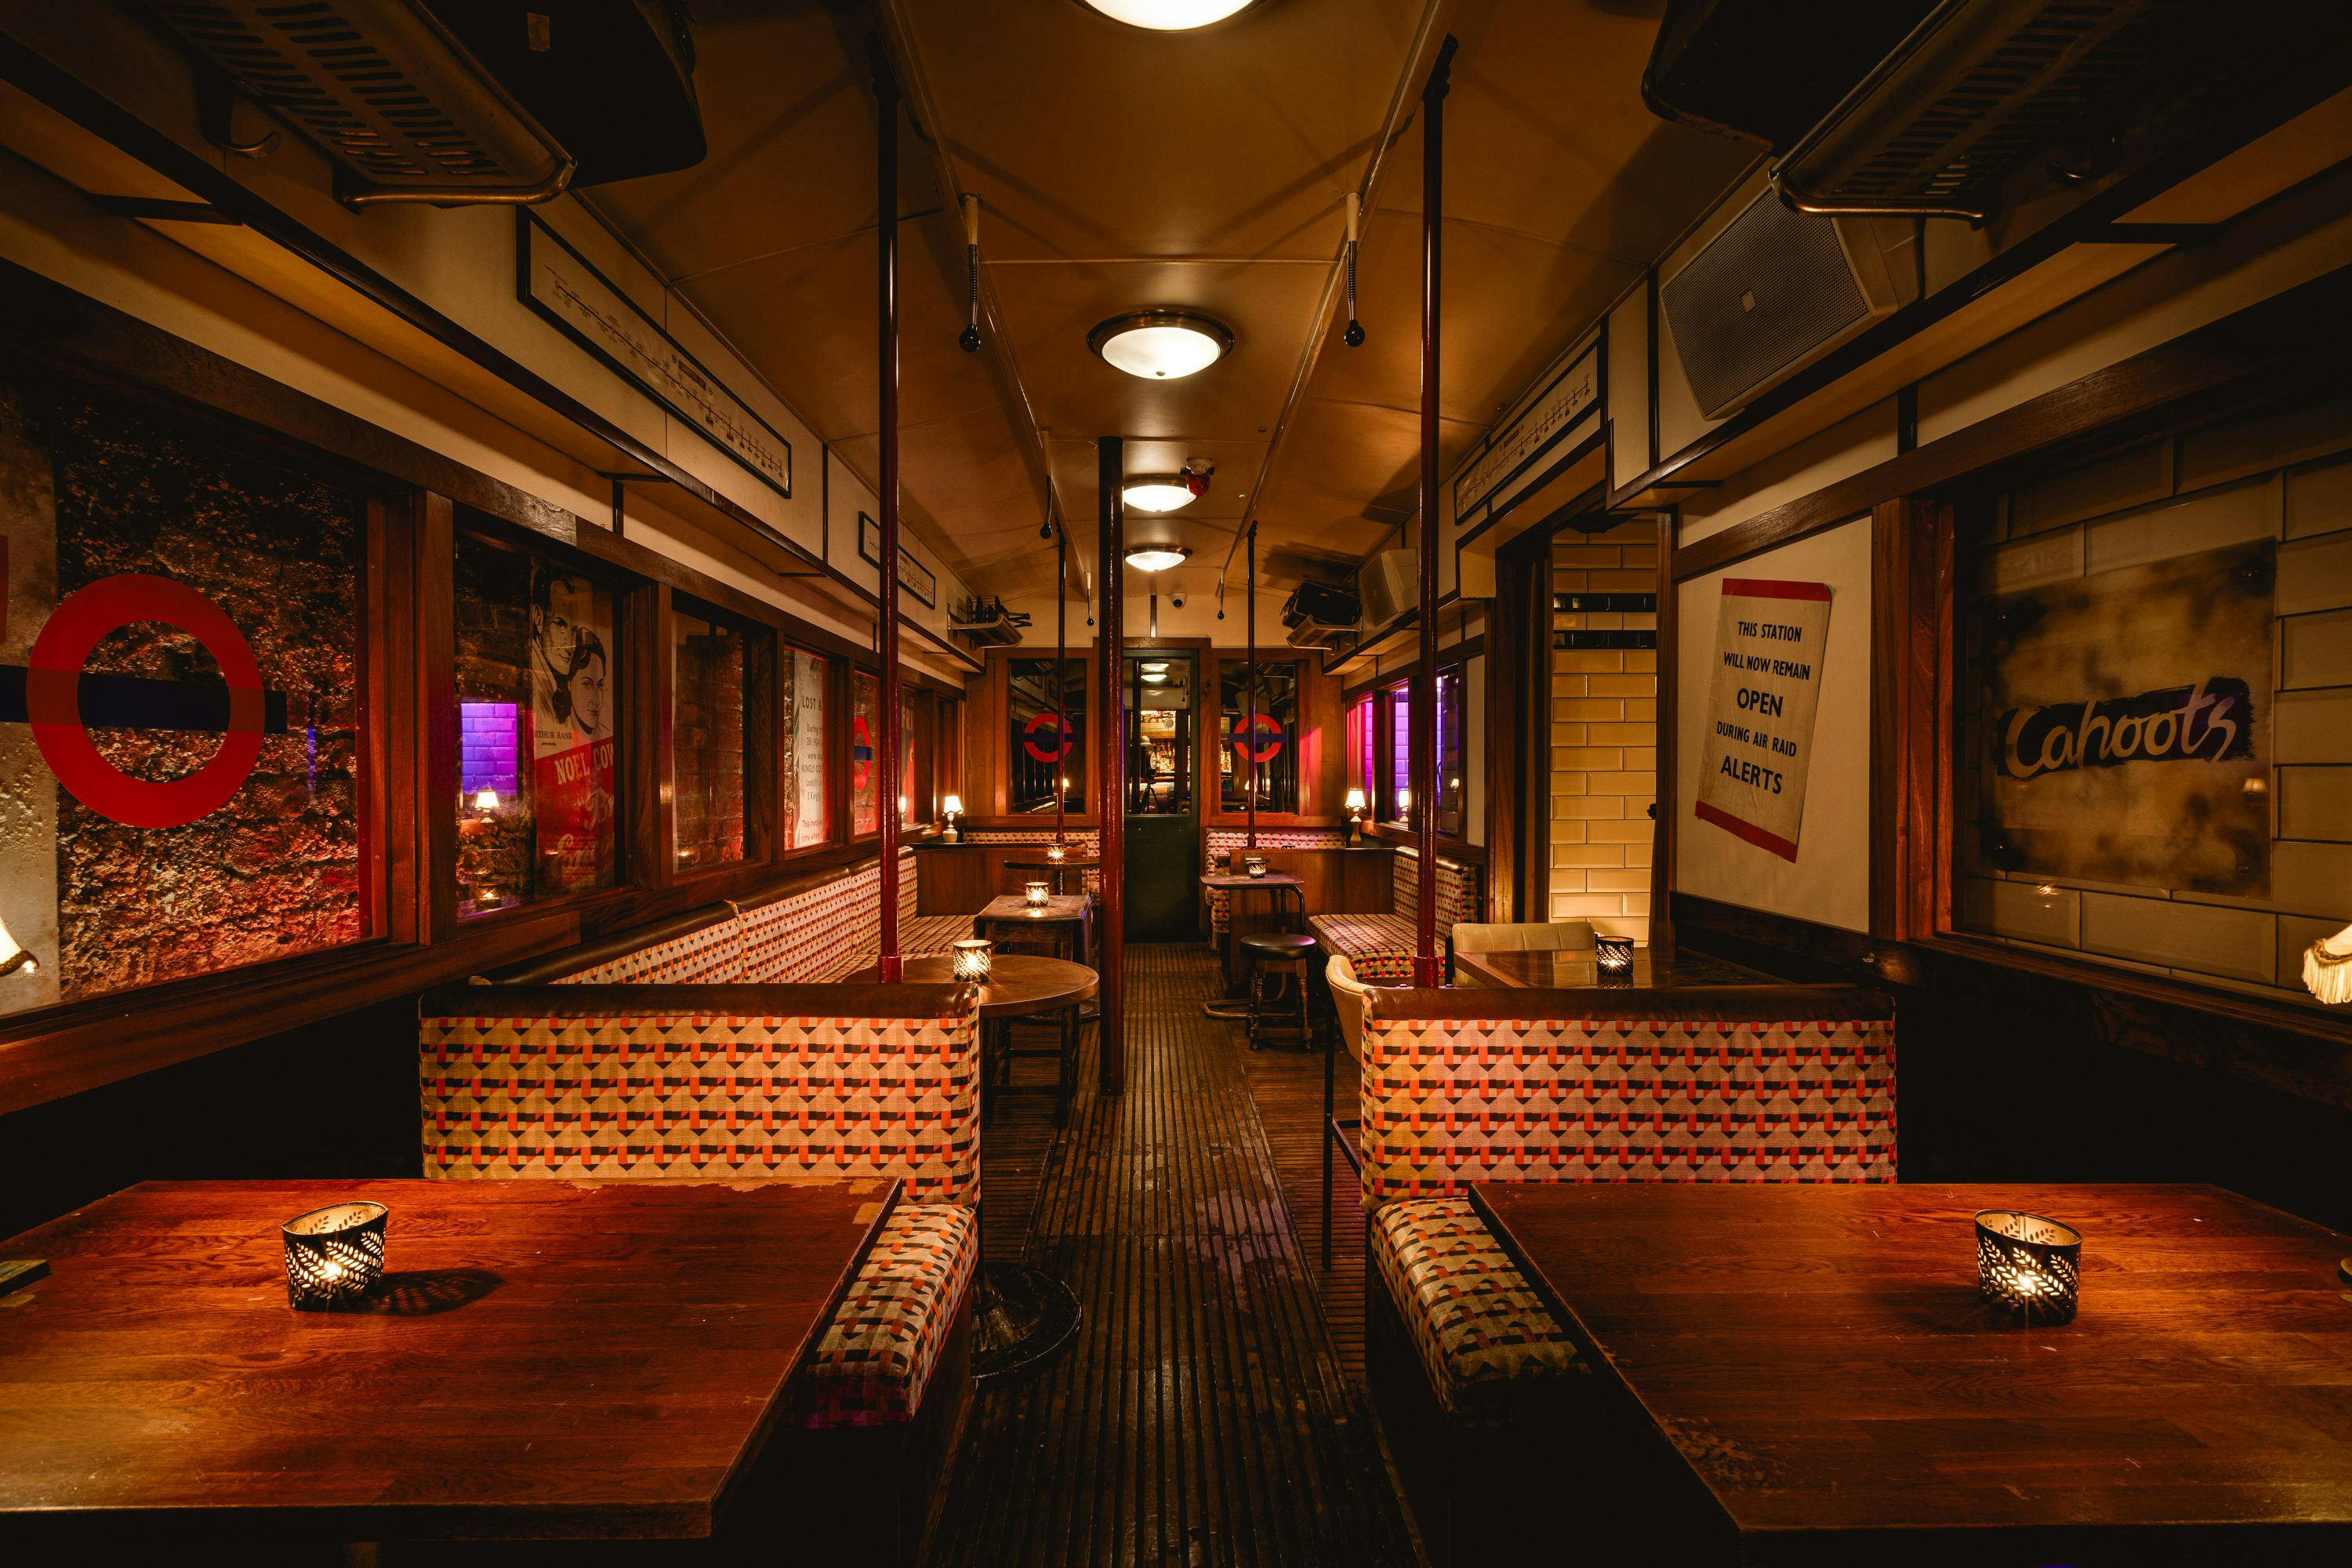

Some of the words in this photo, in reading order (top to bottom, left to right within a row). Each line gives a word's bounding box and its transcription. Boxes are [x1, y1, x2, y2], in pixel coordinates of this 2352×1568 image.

[1738, 622, 1757, 637] THIS
[1761, 624, 1802, 642] STATION
[1724, 652, 1744, 669] WILL
[1747, 656, 1771, 673] NOW
[1773, 659, 1810, 681] REMAIN
[802, 695, 815, 710] LOST
[1737, 688, 1783, 717] OPEN
[1717, 721, 1750, 742] DURING
[1753, 732, 1768, 749] AIR
[1772, 737, 1797, 757] RAID
[2005, 684, 2236, 779] Cahoots
[554, 752, 590, 785] NOEL
[1720, 756, 1783, 794] ALERTS
